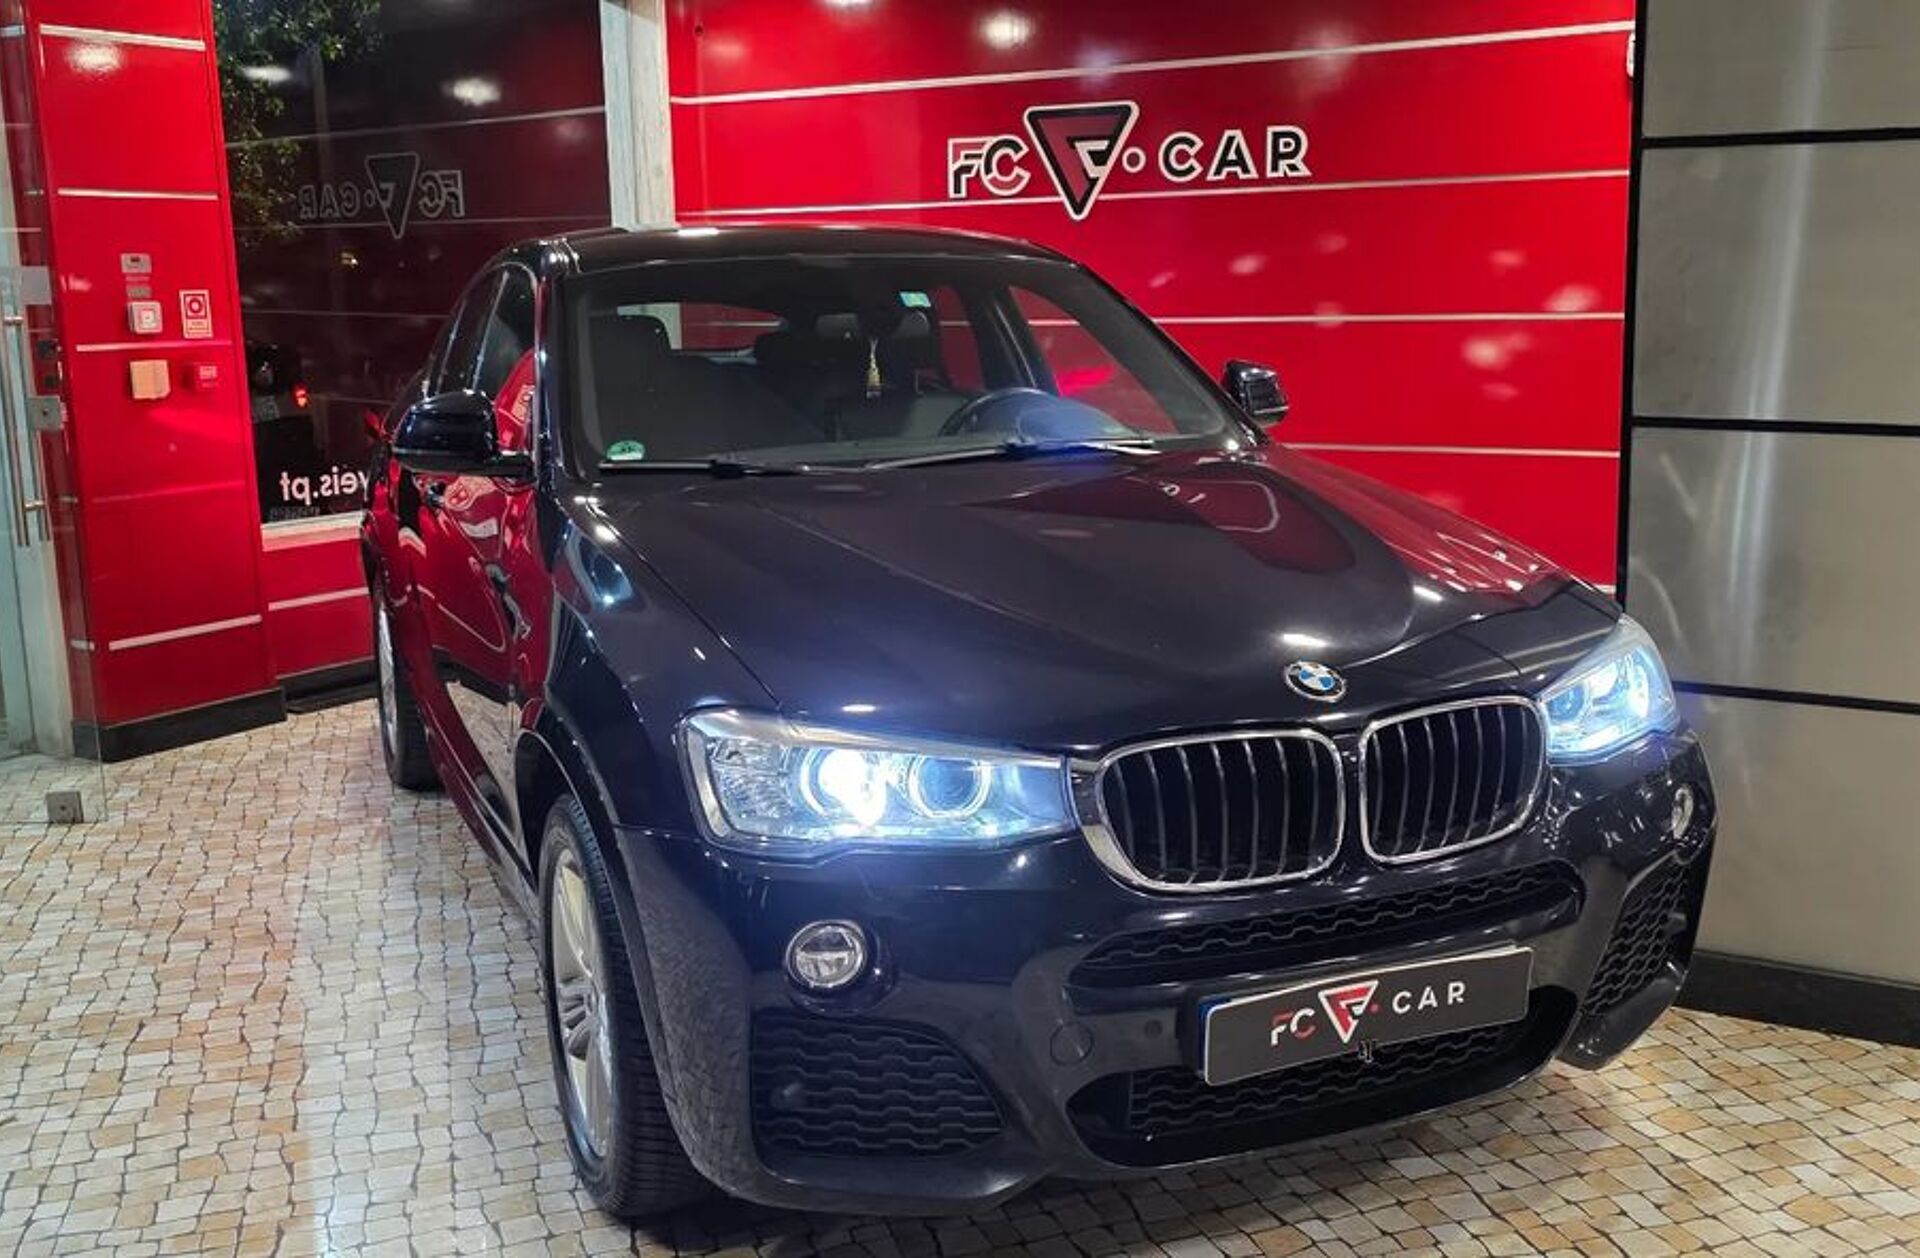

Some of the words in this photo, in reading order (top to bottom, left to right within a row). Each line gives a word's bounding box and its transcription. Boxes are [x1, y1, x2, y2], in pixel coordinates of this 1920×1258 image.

[948, 135, 1030, 199] FC
[1159, 126, 1311, 182] CAR
[1270, 1007, 1319, 1048] FC
[1392, 980, 1467, 1015] CAR
